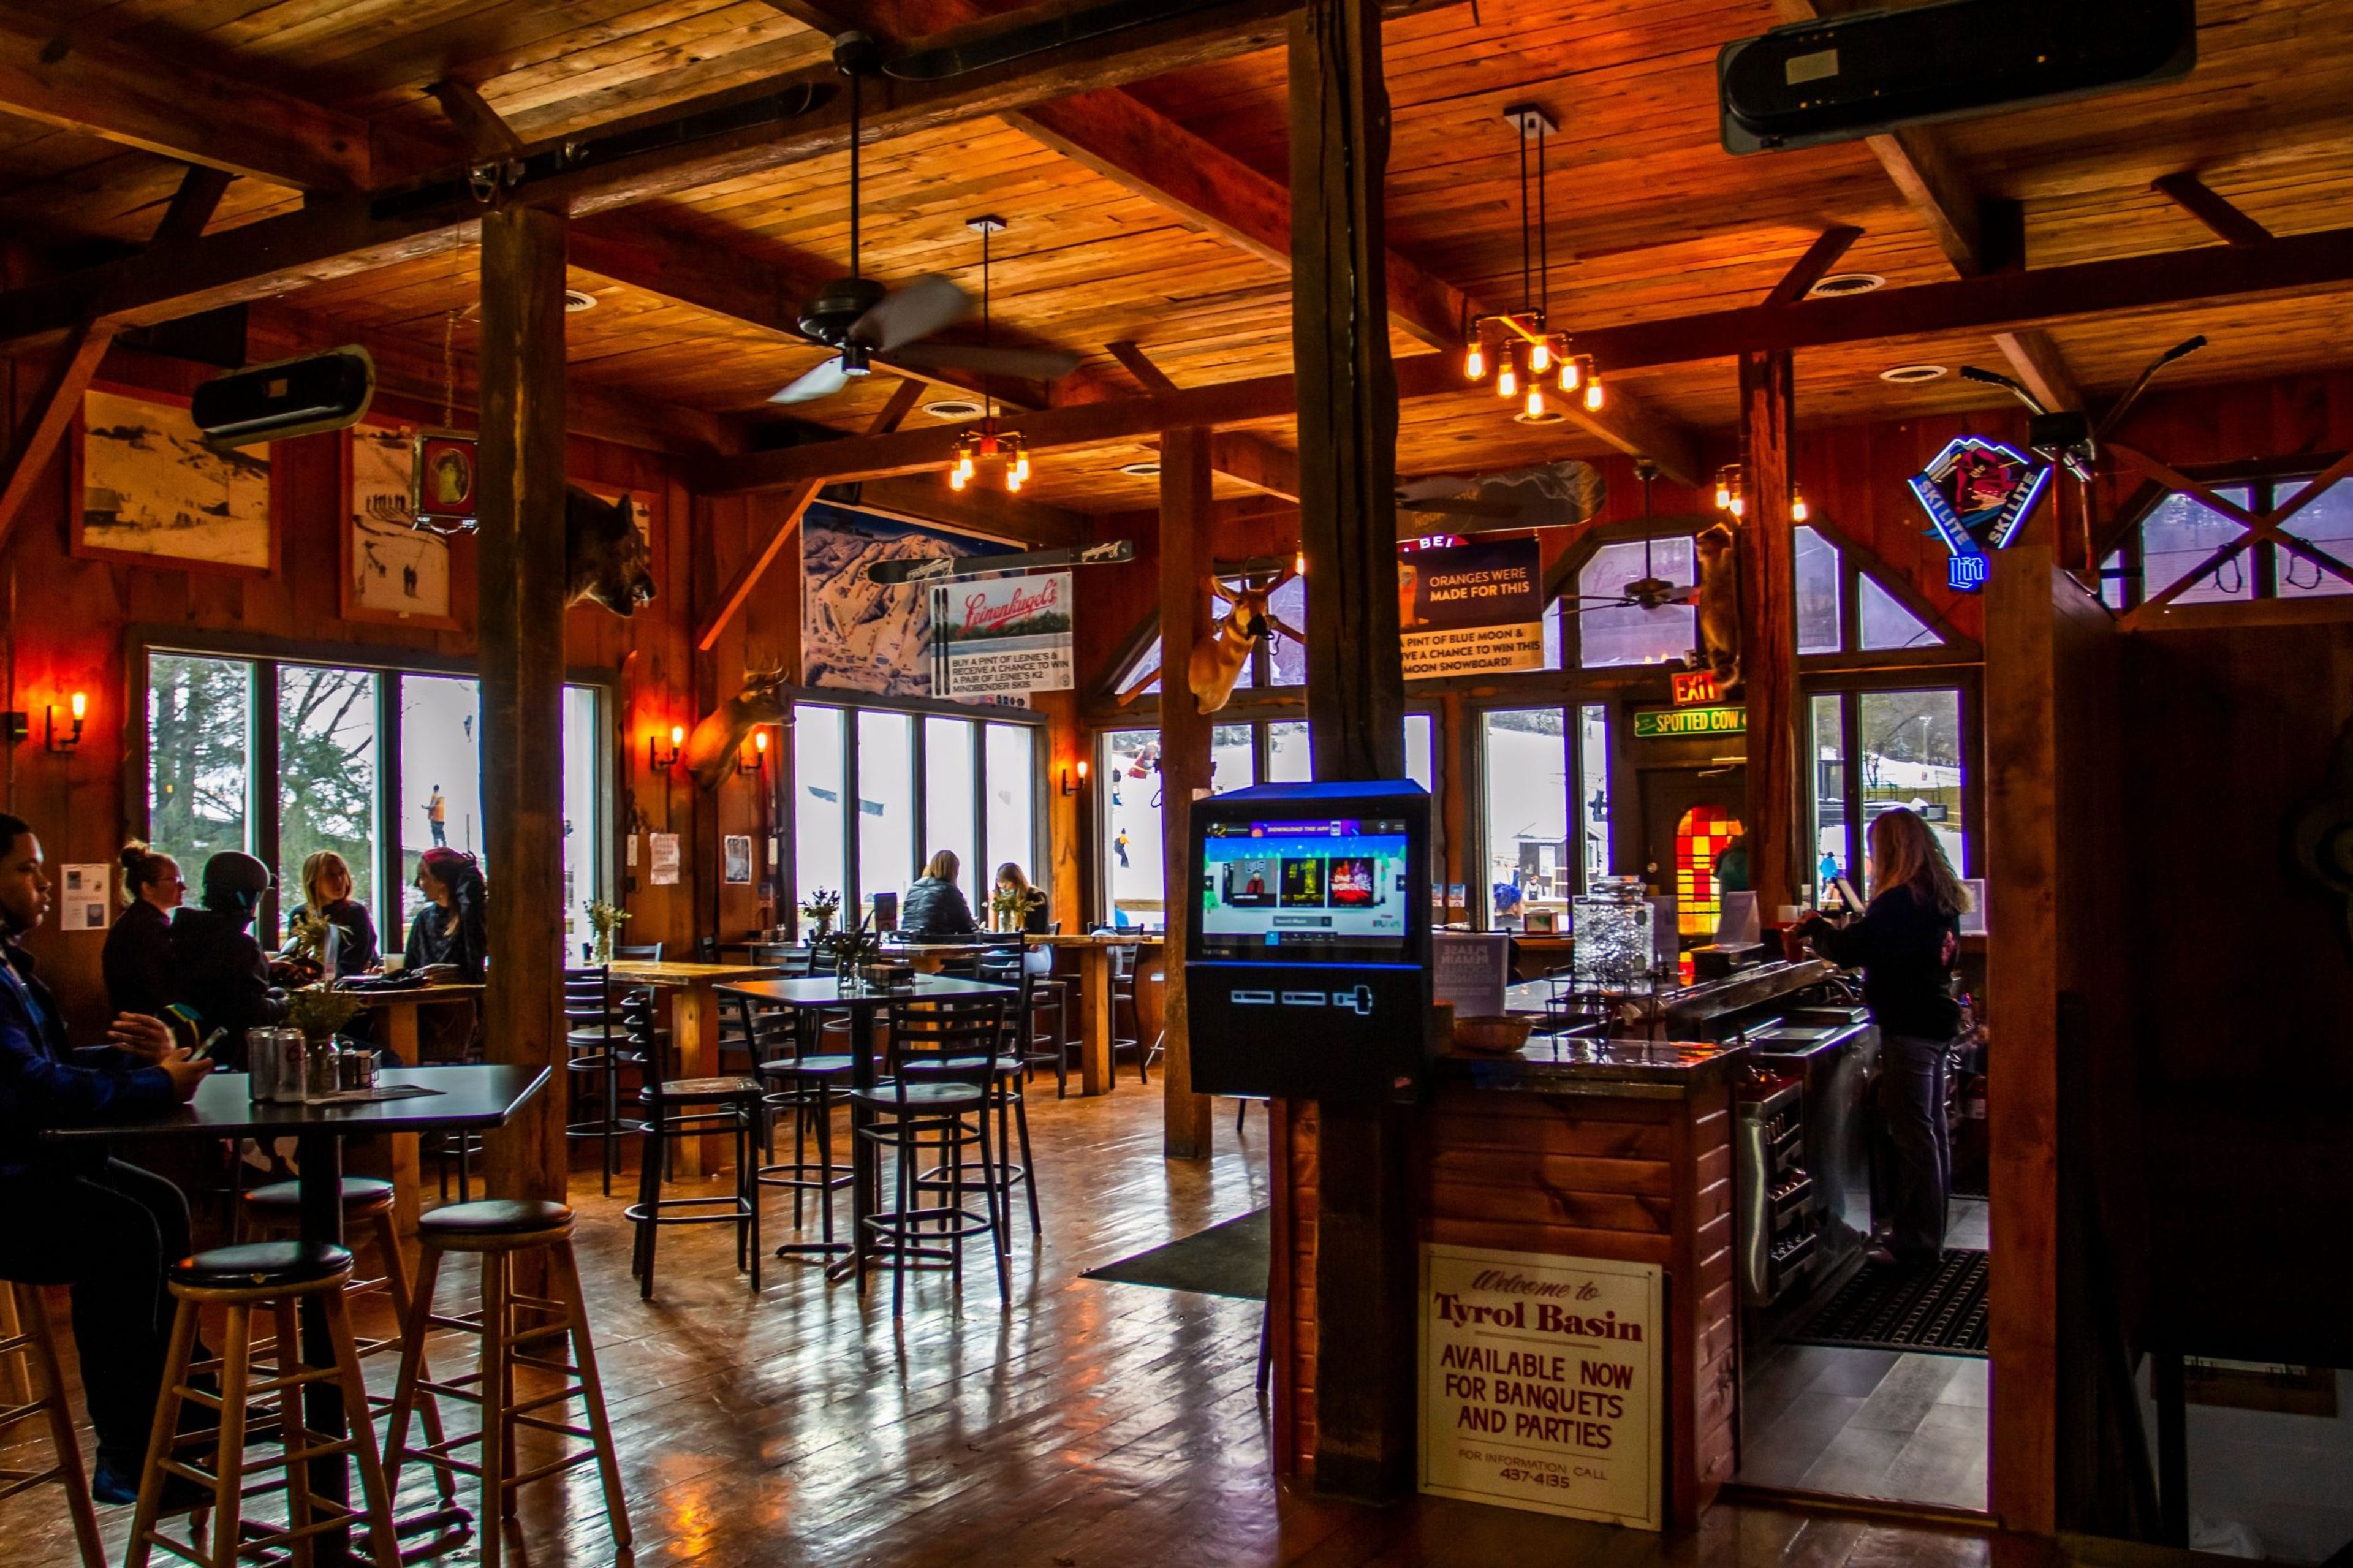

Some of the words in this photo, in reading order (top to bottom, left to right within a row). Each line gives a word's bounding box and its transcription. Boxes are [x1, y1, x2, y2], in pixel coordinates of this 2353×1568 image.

[1918, 480, 1944, 509] SKI
[1938, 508, 1971, 546] LITE
[1988, 513, 2014, 544] SKI
[2007, 471, 2037, 512] LITE
[1430, 571, 1490, 588] ORANGES
[1491, 567, 1526, 580] WERE
[1430, 587, 1468, 602] MADE
[1471, 585, 1498, 598] FOR
[1500, 581, 1530, 594] THIS
[956, 578, 1058, 637] Leinenkugel's
[1407, 637, 1430, 647] PINT
[1433, 635, 1447, 645] OF
[1450, 632, 1474, 643] BLUE
[1477, 629, 1512, 640] MOON
[1515, 628, 1523, 638] &
[952, 658, 968, 667] BUY
[980, 656, 998, 665] PINT
[1000, 655, 1012, 664] OF
[1014, 652, 1049, 662] LEINIE'S
[1430, 646, 1473, 659] CHANCE
[1476, 645, 1490, 654] TO
[1493, 642, 1515, 653] WIN
[1517, 640, 1540, 651] THIS
[952, 666, 988, 676] RECEIVE
[998, 662, 1036, 672] CHANCE
[1051, 660, 1069, 668] WIN
[1403, 663, 1437, 673] MOON
[1439, 657, 1512, 671] SNOWBOARD!
[953, 683, 1010, 692] MINDBENDER
[960, 675, 979, 684] PAIR
[995, 672, 1030, 682] LEINIE'S
[1676, 675, 1716, 702] EXIT
[1656, 712, 1708, 732] SPOTTED
[1711, 711, 1739, 729] COW
[1471, 1269, 1571, 1299] Welcome
[1575, 1281, 1601, 1301] to
[1434, 1291, 1526, 1328] Tyrol
[1536, 1303, 1643, 1343] Basin
[1441, 1344, 1566, 1382] AVAILABLE
[1580, 1360, 1634, 1390] NOW
[1446, 1373, 1486, 1401] FOR
[1495, 1379, 1624, 1420] BANQUETS
[1457, 1405, 1507, 1434] AND
[1516, 1413, 1613, 1450] PARTIES
[1458, 1449, 1482, 1461] FOR
[1485, 1452, 1567, 1475] INFORMATION
[1573, 1467, 1608, 1482] CALL
[1500, 1468, 1570, 1489] 437-4135
